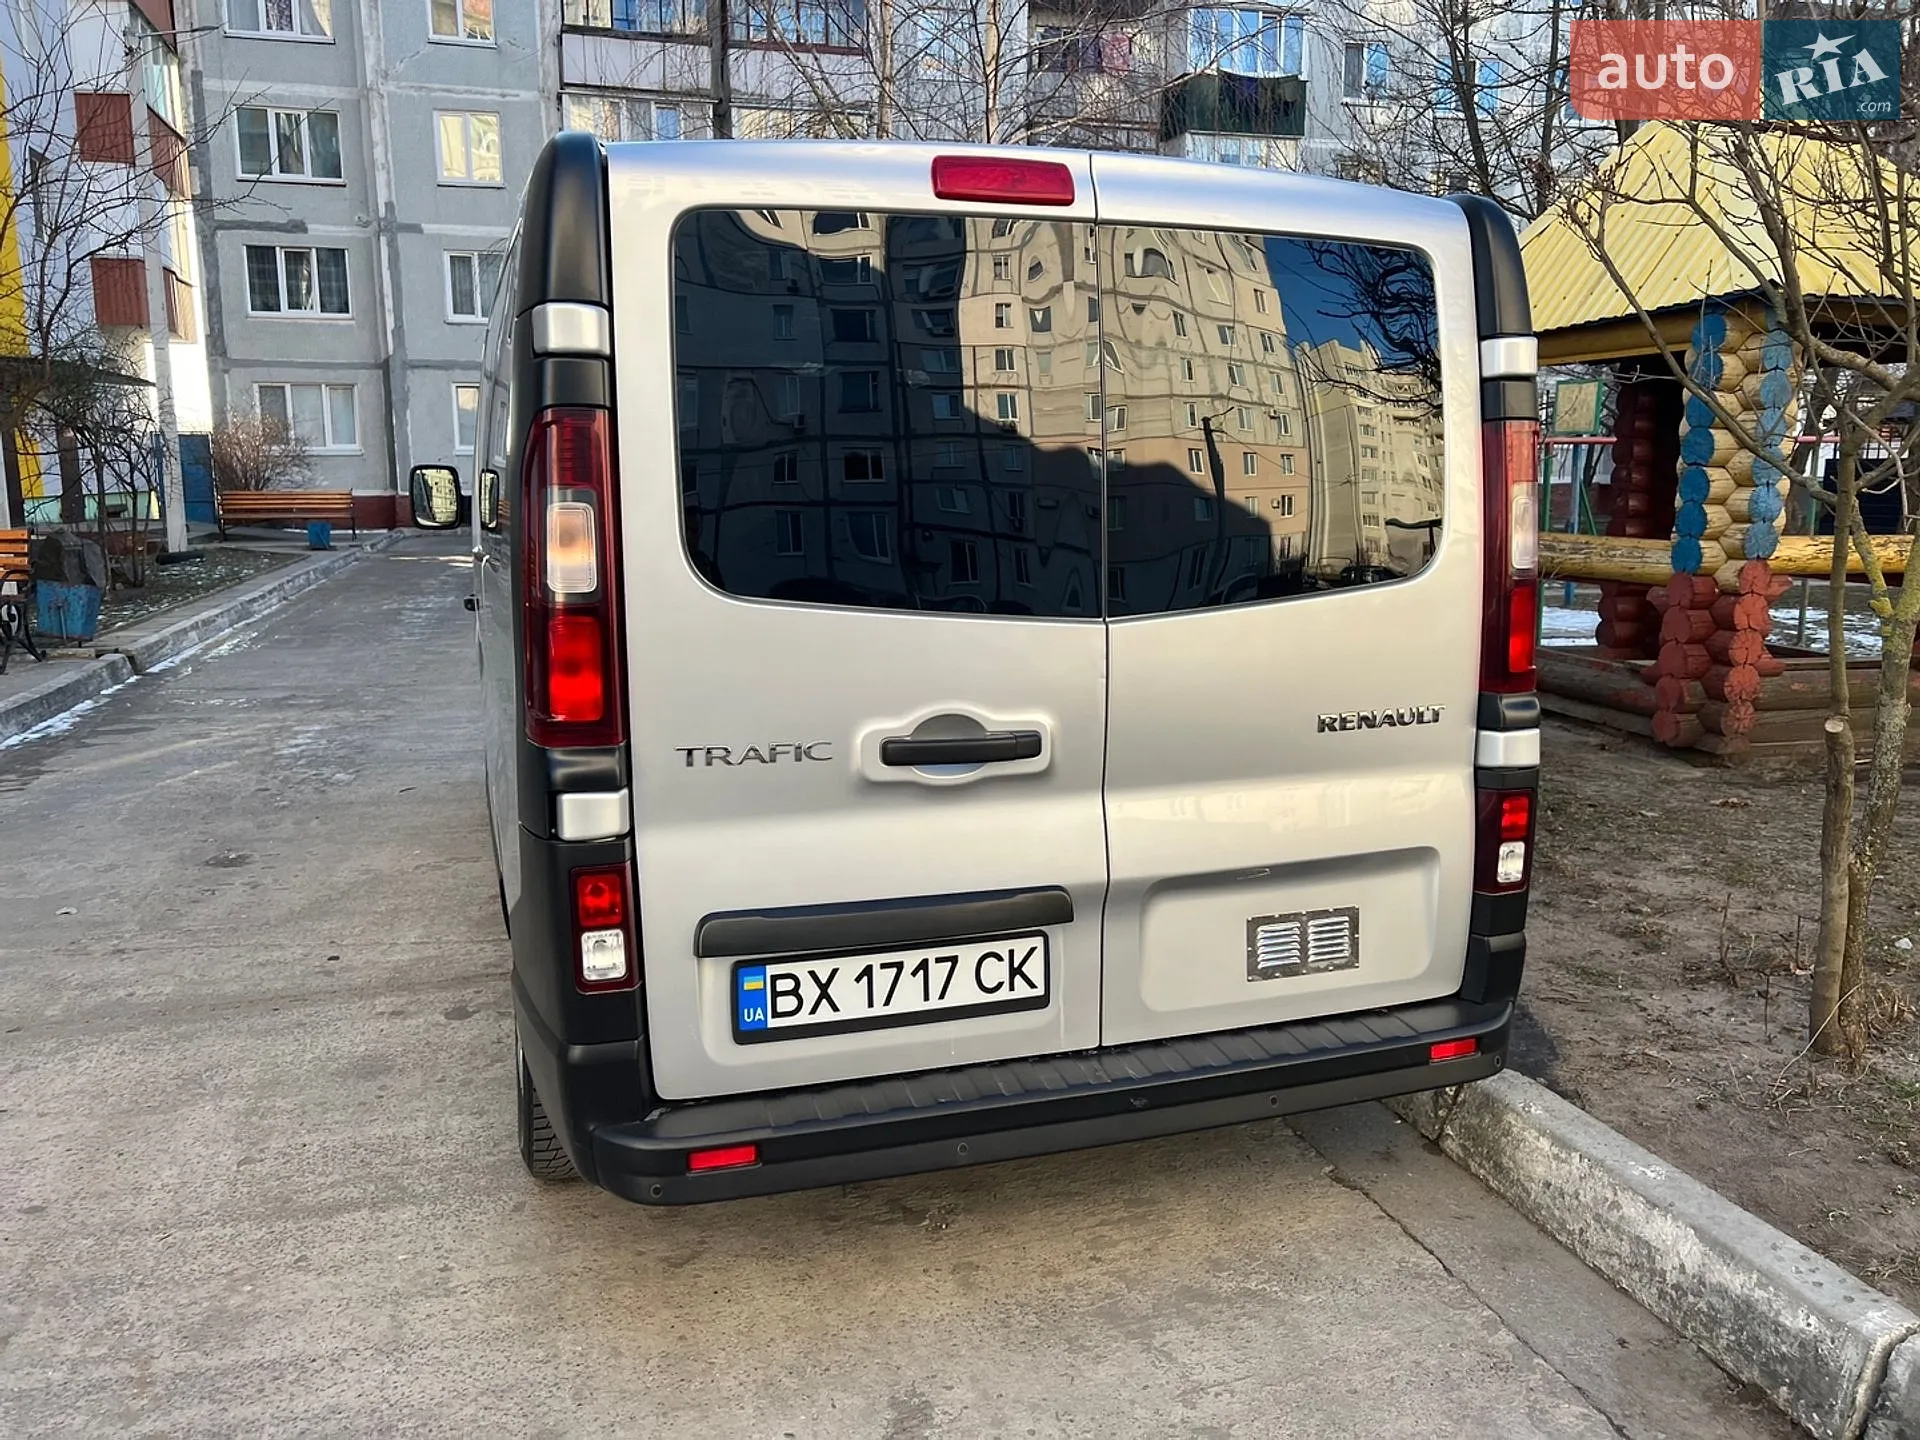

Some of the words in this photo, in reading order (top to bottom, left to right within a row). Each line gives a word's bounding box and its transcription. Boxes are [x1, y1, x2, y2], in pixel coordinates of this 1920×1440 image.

[1317, 705, 1446, 733] RENAULT
[674, 741, 833, 767] TRAFIC
[770, 967, 841, 1019] BX
[854, 954, 959, 1009] 1717
[974, 946, 1038, 994] CK
[743, 1008, 765, 1022] UA
